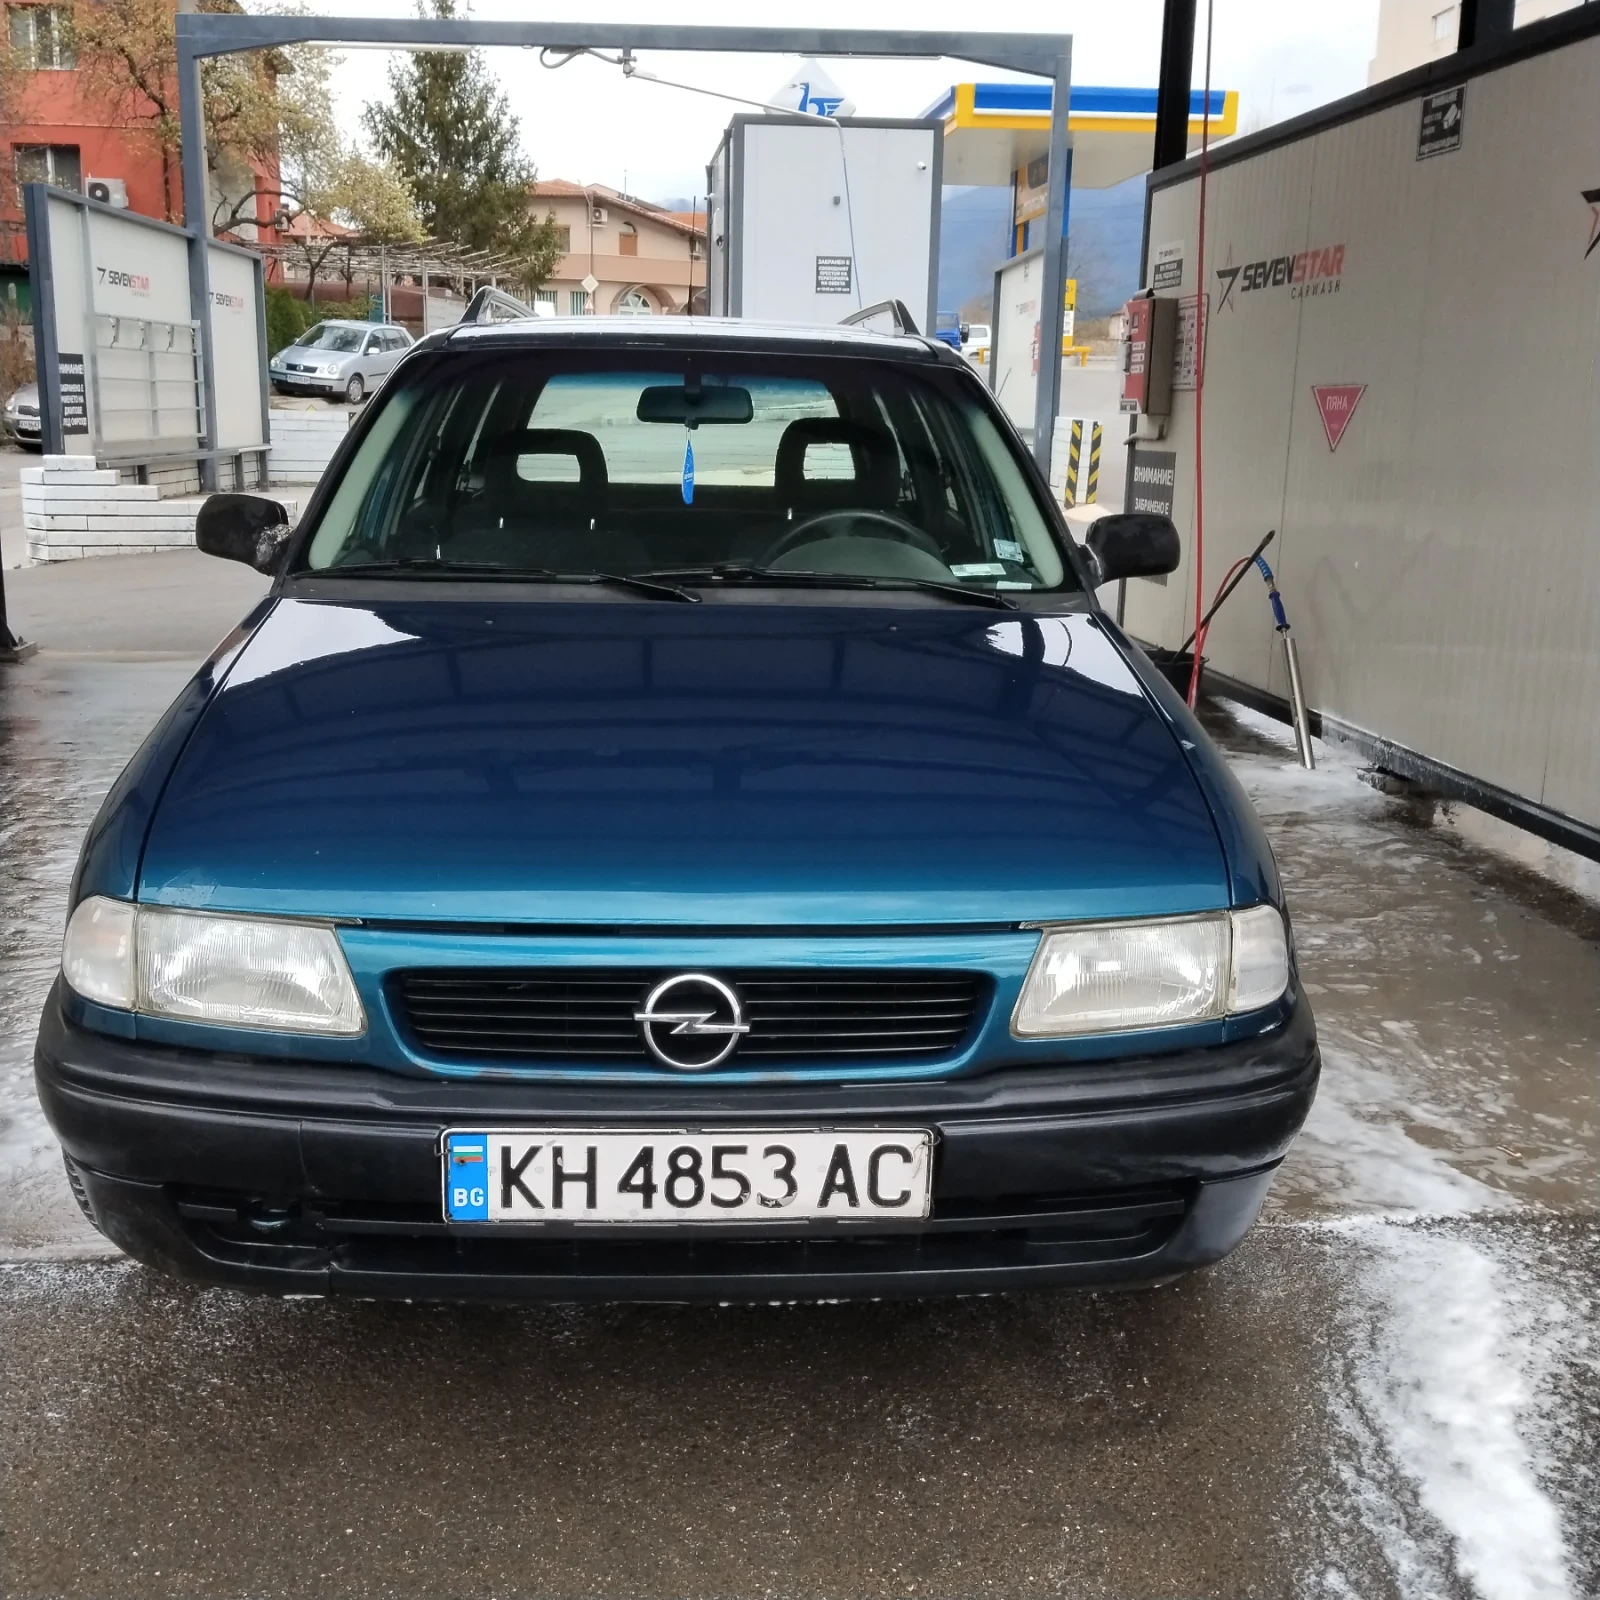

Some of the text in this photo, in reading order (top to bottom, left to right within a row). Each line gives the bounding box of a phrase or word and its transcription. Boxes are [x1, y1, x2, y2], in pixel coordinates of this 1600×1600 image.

[1291, 280, 1341, 300] CARWASH
[1326, 395, 1348, 410] ПЯНА
[1134, 466, 1174, 486] ВНИМАНИЕ!
[1134, 497, 1165, 514] ЗАБРАНЕНО
[500, 1143, 914, 1209] KH 4853 AC
[453, 1187, 485, 1207] BG
